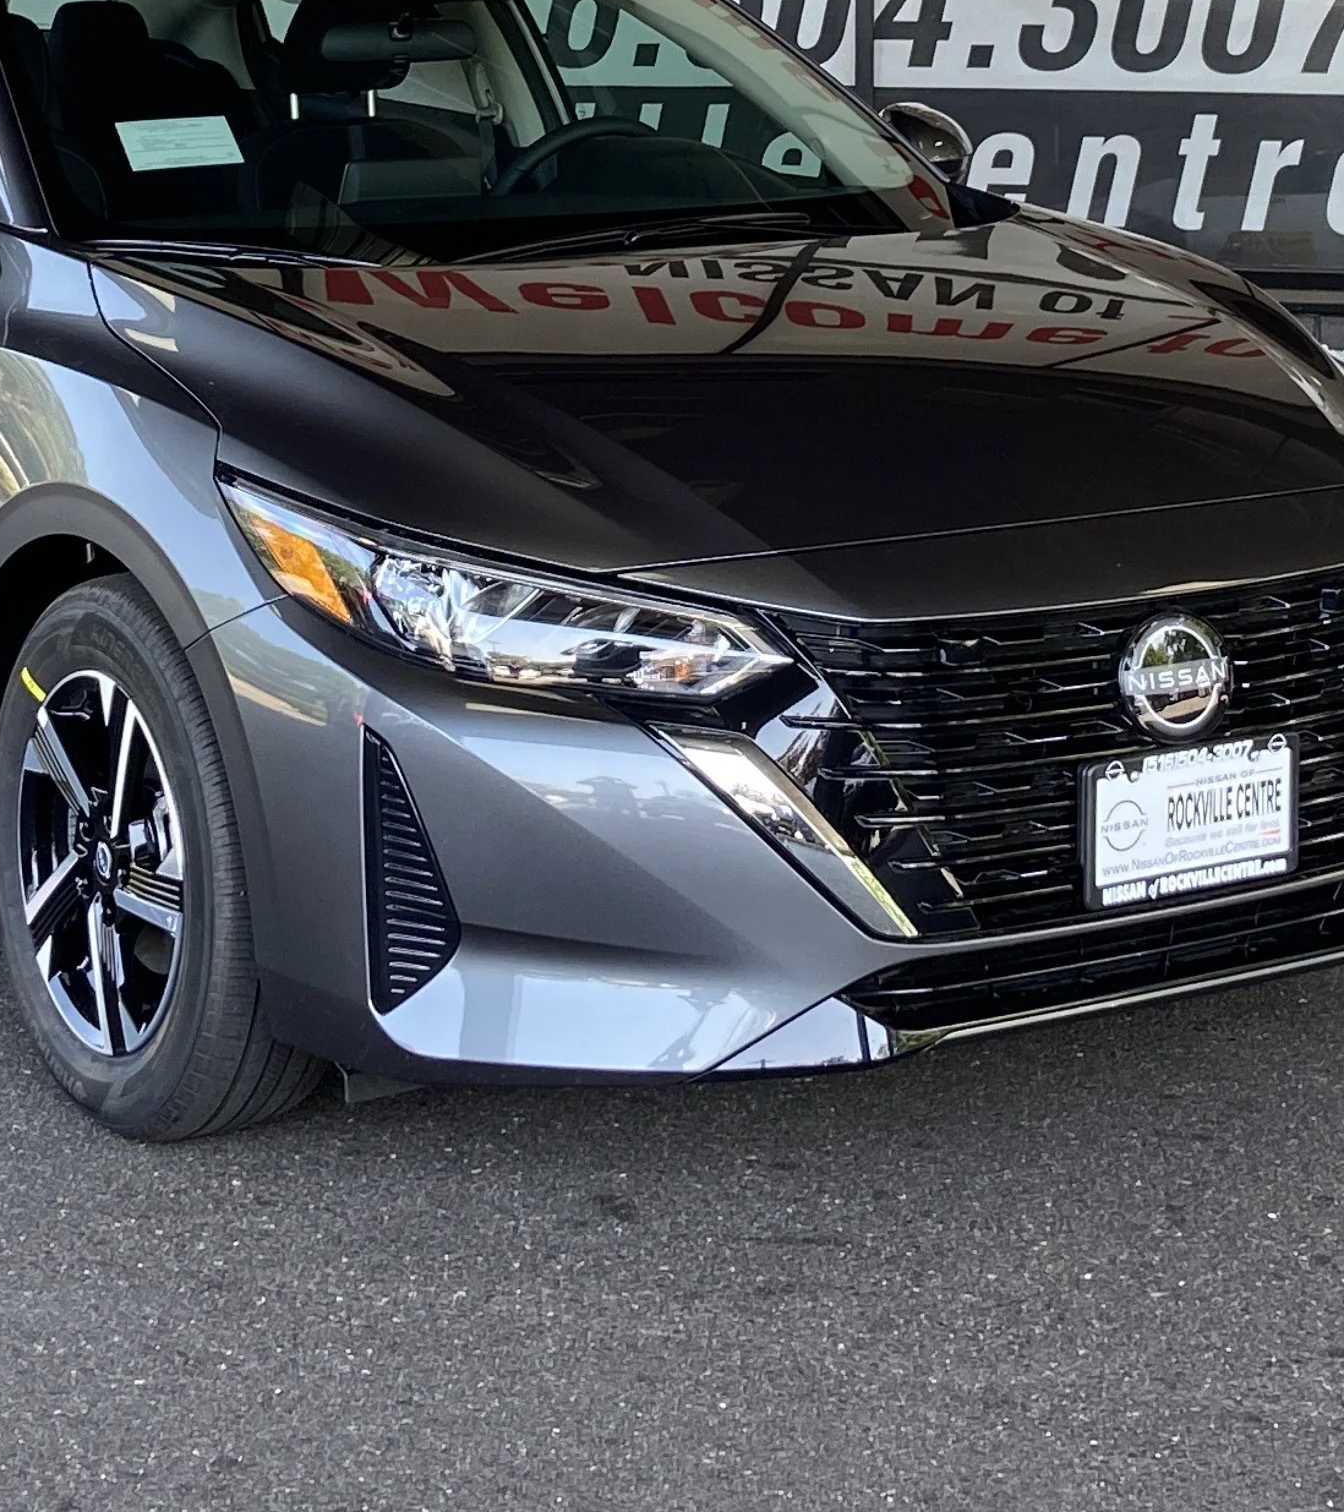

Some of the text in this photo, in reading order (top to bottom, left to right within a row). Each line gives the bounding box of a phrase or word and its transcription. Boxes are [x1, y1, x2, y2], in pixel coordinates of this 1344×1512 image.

[1127, 655, 1230, 692] NISSAN
[1195, 769, 1256, 787] NISSAN OF
[1167, 777, 1282, 832] ROCKVILLE CENTRE
[1101, 817, 1149, 834] NISSAN
[1102, 880, 1147, 907] NISSAN
